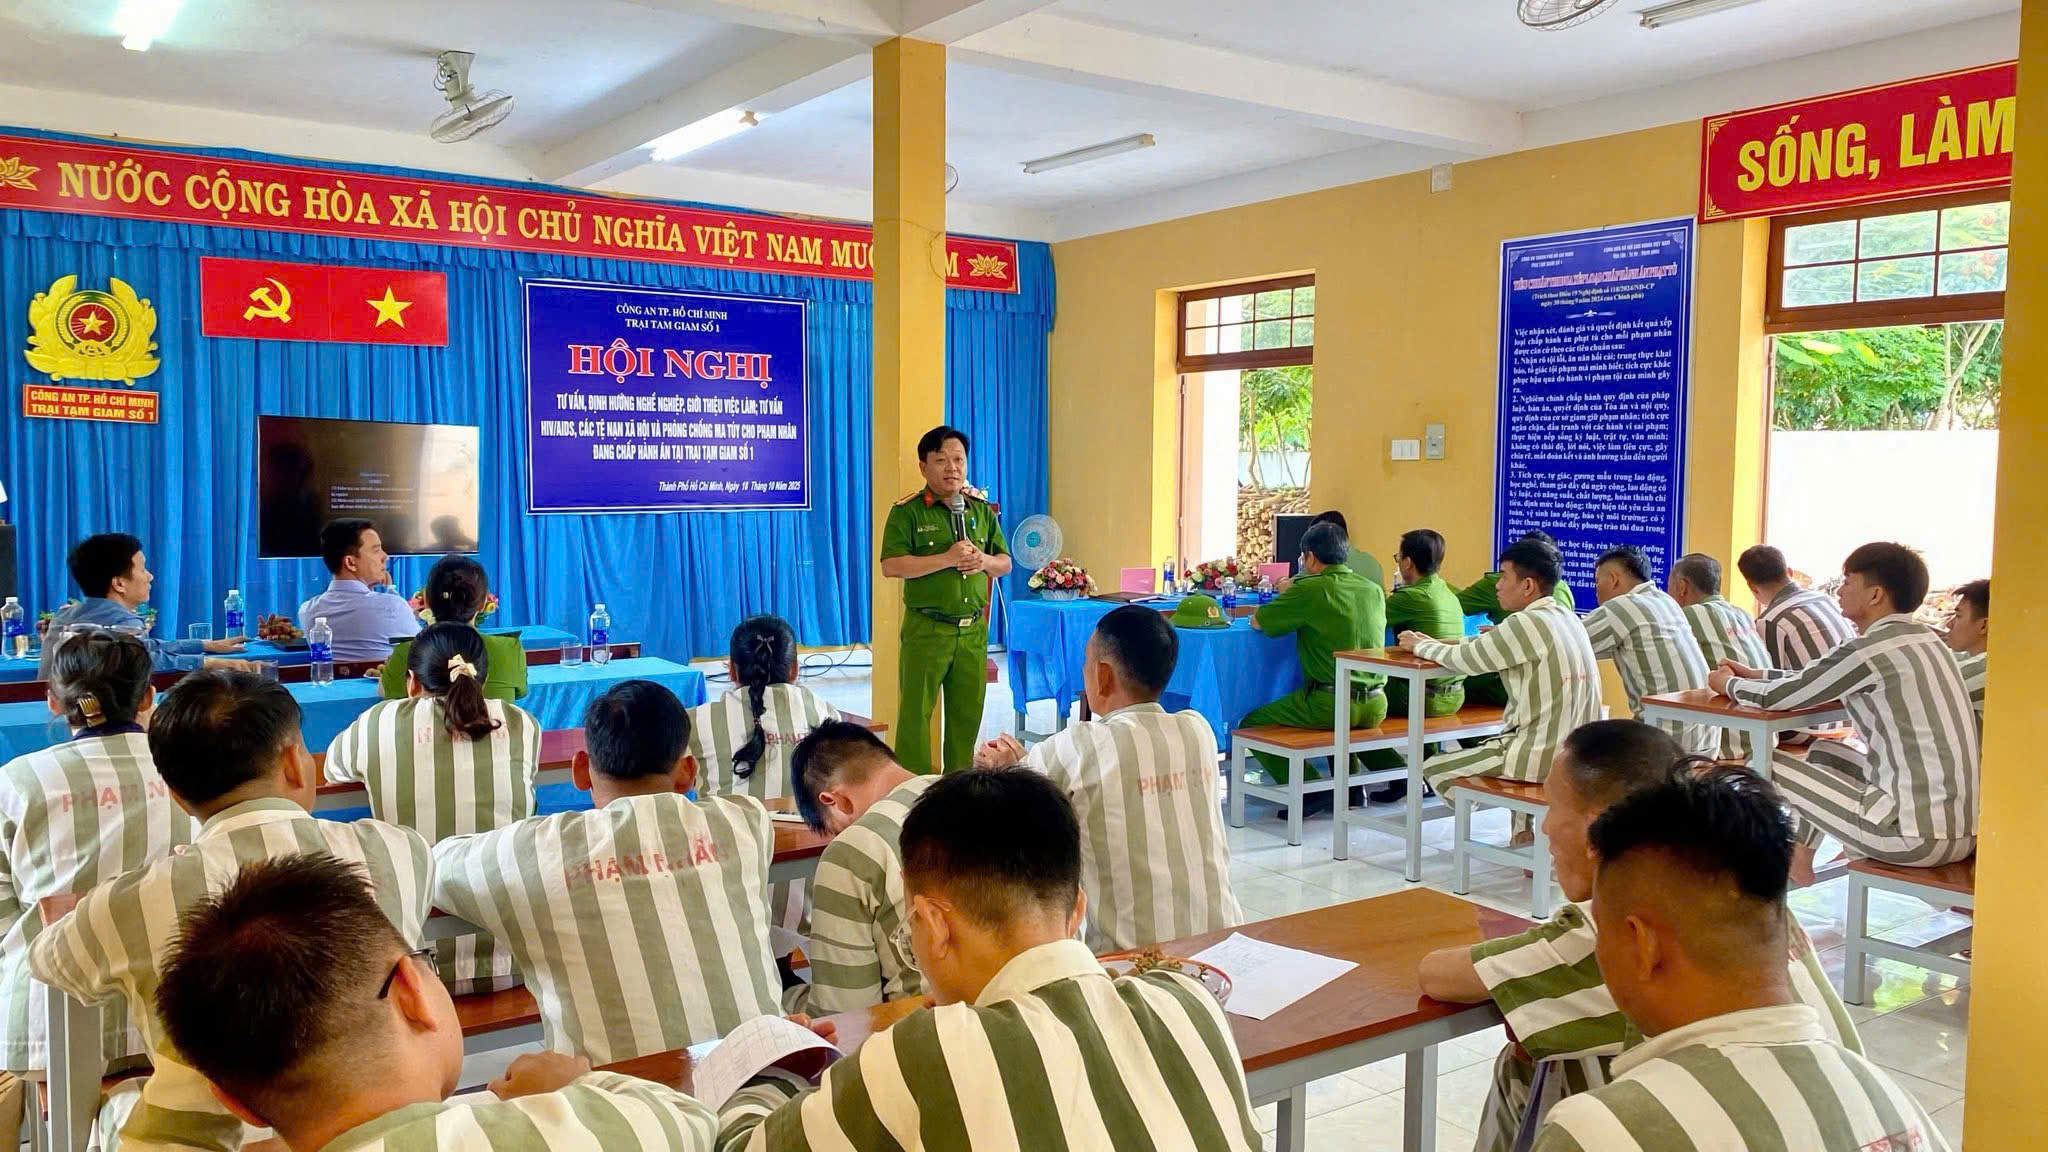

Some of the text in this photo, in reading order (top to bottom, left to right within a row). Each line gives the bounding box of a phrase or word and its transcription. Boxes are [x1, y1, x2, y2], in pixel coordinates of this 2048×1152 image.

[1738, 95, 2016, 192] SỐNG, LÀM
[58, 158, 873, 270] NƯỚC CỘNG HÒA XÃ HỘI CHỦ NGHĨA VIỆT NAM MU
[616, 302, 727, 320] CÔNG AN TP. HỒ CHÍ MINH
[625, 318, 648, 330] TRẠI
[674, 321, 700, 331] GIAM
[701, 320, 714, 332] SỐ
[716, 324, 720, 332] 1
[568, 338, 772, 389] HỘI NGHỊ
[31, 389, 58, 401] CÔNG
[61, 392, 77, 402] AN
[78, 393, 91, 403] TP.
[110, 394, 126, 406] CHÍ
[128, 397, 154, 408] MINH
[557, 393, 568, 410] TƯ
[568, 389, 587, 412] VẤN,
[588, 395, 607, 414] ĐỊNH
[608, 392, 634, 411] HƯỚNG
[658, 394, 686, 415] NGHIỆP,
[687, 395, 701, 412] GIỚI
[702, 396, 722, 416] THIỆU
[724, 396, 740, 417] VIỆC
[741, 396, 758, 416] LÀM;
[759, 399, 769, 414] TƯ
[769, 396, 783, 415] VẤN
[31, 404, 59, 415] TRẠI
[93, 408, 125, 418] GIAM
[128, 408, 144, 419] SỐ
[148, 411, 154, 420] 1
[541, 418, 797, 442] HIV/AIDS, CÁC TỆ NẠN XÃ HỘI VÀ PHÒNG CHỐNG MA TÚY CHO PHẠM NHÂN
[593, 440, 754, 464] ĐANG CHẤP HÀNH ÁN TẠI TRẠI TẠM GIAM SỐ 1
[659, 481, 677, 491] Thành
[677, 480, 690, 491] Phố
[690, 480, 698, 491] Hồ
[699, 481, 709, 491] Chí
[709, 481, 724, 492] Minh,
[725, 481, 740, 493] Ngày
[751, 481, 767, 493] Tháng
[768, 481, 775, 491] 10
[775, 481, 787, 491] Năm
[788, 481, 800, 491] 2025
